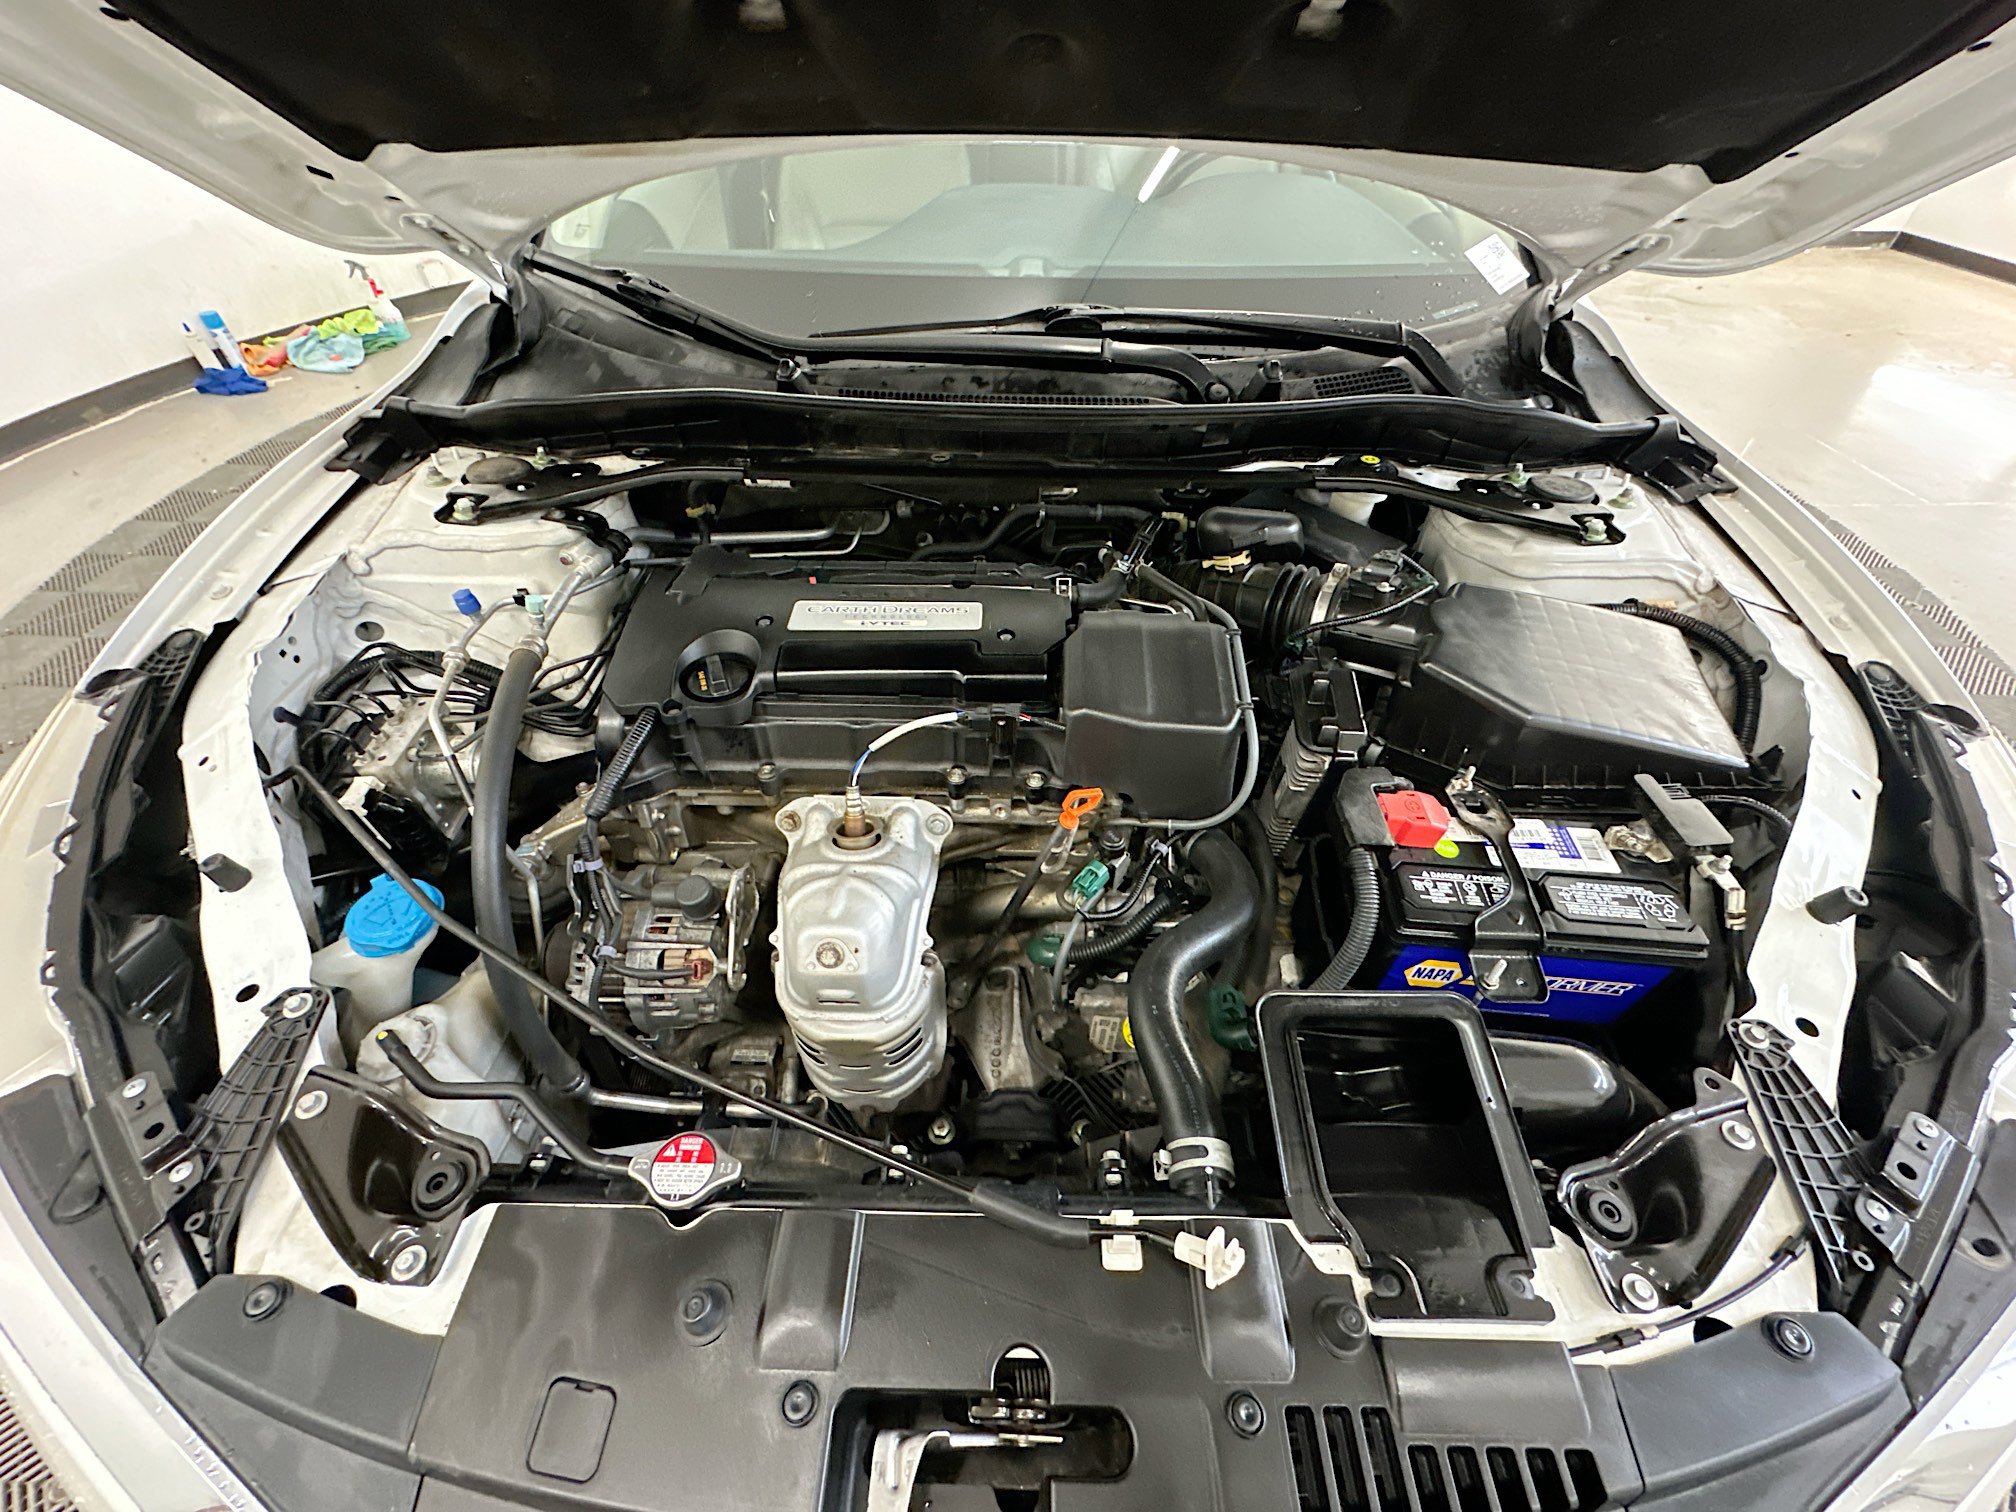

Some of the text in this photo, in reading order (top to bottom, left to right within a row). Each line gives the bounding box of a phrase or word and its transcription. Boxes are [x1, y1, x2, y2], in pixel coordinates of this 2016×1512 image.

[807, 605, 877, 614] EARTH
[1429, 871, 1466, 881] DANGER
[1473, 875, 1505, 883] POISON
[1411, 966, 1457, 981] NAPA
